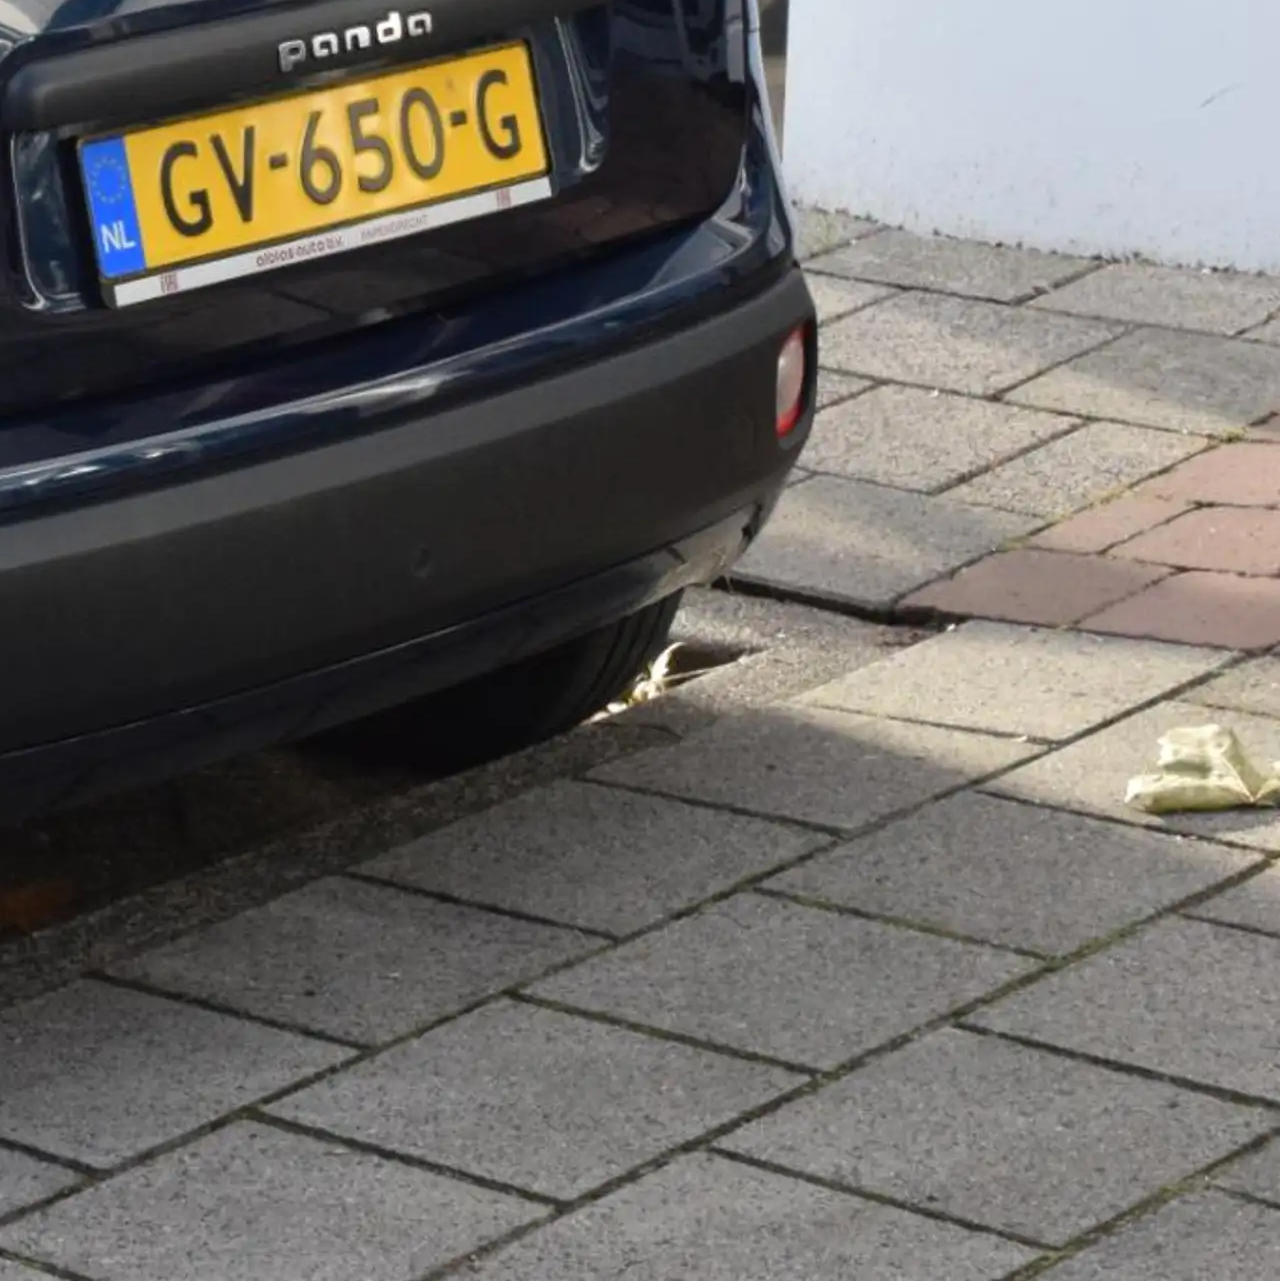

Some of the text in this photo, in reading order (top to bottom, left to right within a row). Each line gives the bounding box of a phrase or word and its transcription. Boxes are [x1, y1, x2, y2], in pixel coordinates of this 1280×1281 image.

[277, 10, 433, 72] panda
[159, 69, 523, 238] GV-650-G
[101, 219, 137, 253] NL
